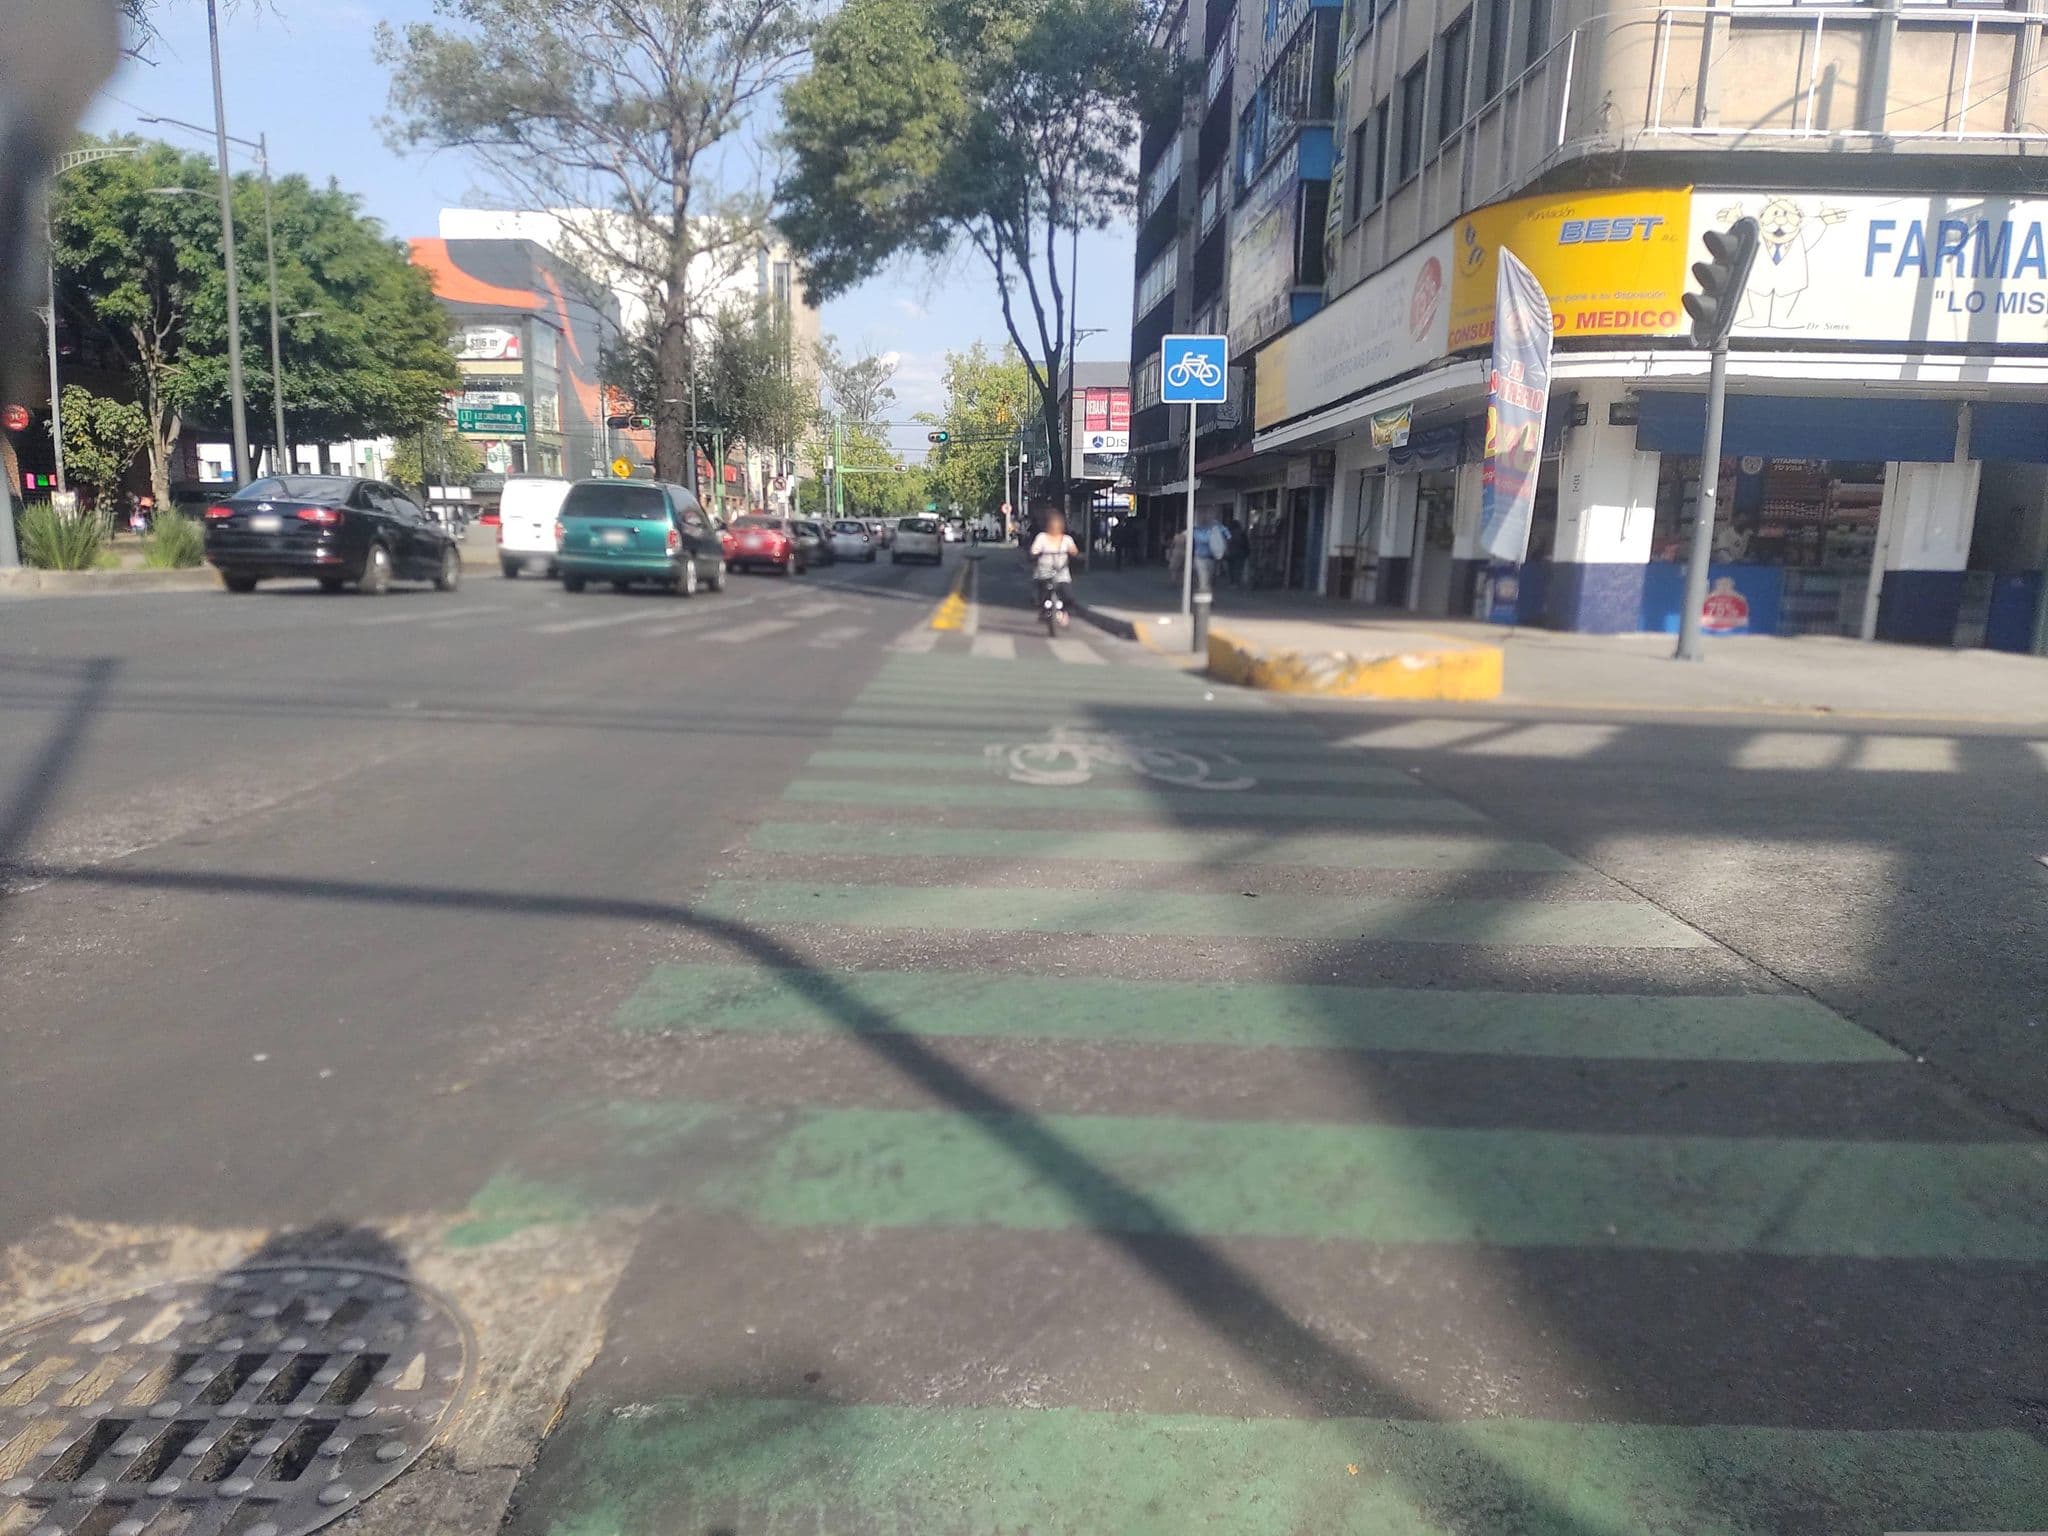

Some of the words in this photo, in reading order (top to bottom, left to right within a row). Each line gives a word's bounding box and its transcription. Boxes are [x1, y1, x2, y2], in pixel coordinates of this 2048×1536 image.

[1559, 216, 1664, 245] BEST
[1864, 219, 2047, 279] FARMA
[1995, 291, 2048, 314] MIS
[1576, 310, 1678, 330] MEDICO
